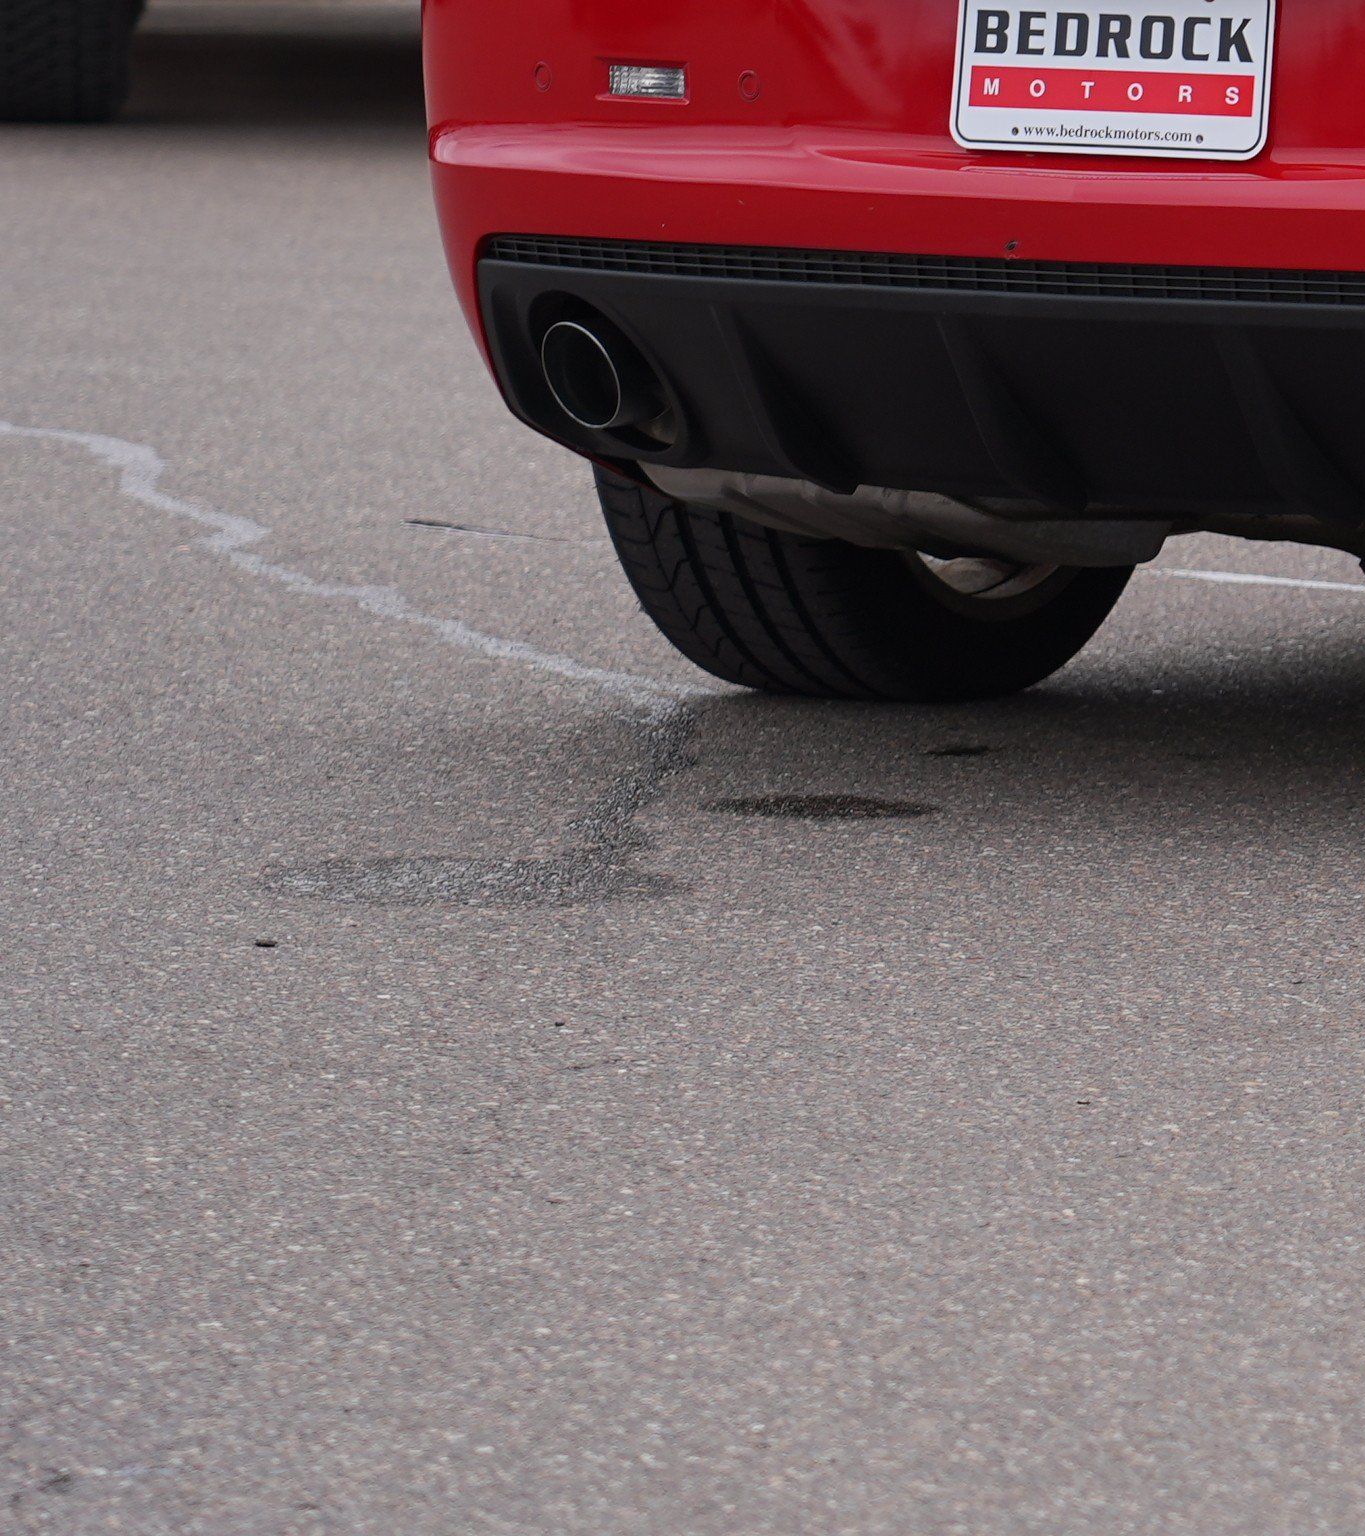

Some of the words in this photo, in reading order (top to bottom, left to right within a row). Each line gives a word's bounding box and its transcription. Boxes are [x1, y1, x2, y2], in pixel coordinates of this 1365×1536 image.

[973, 9, 1255, 62] BEDROCK
[982, 77, 1240, 106] MOTORS
[1022, 123, 1193, 143] www.bedrockmotors.com
